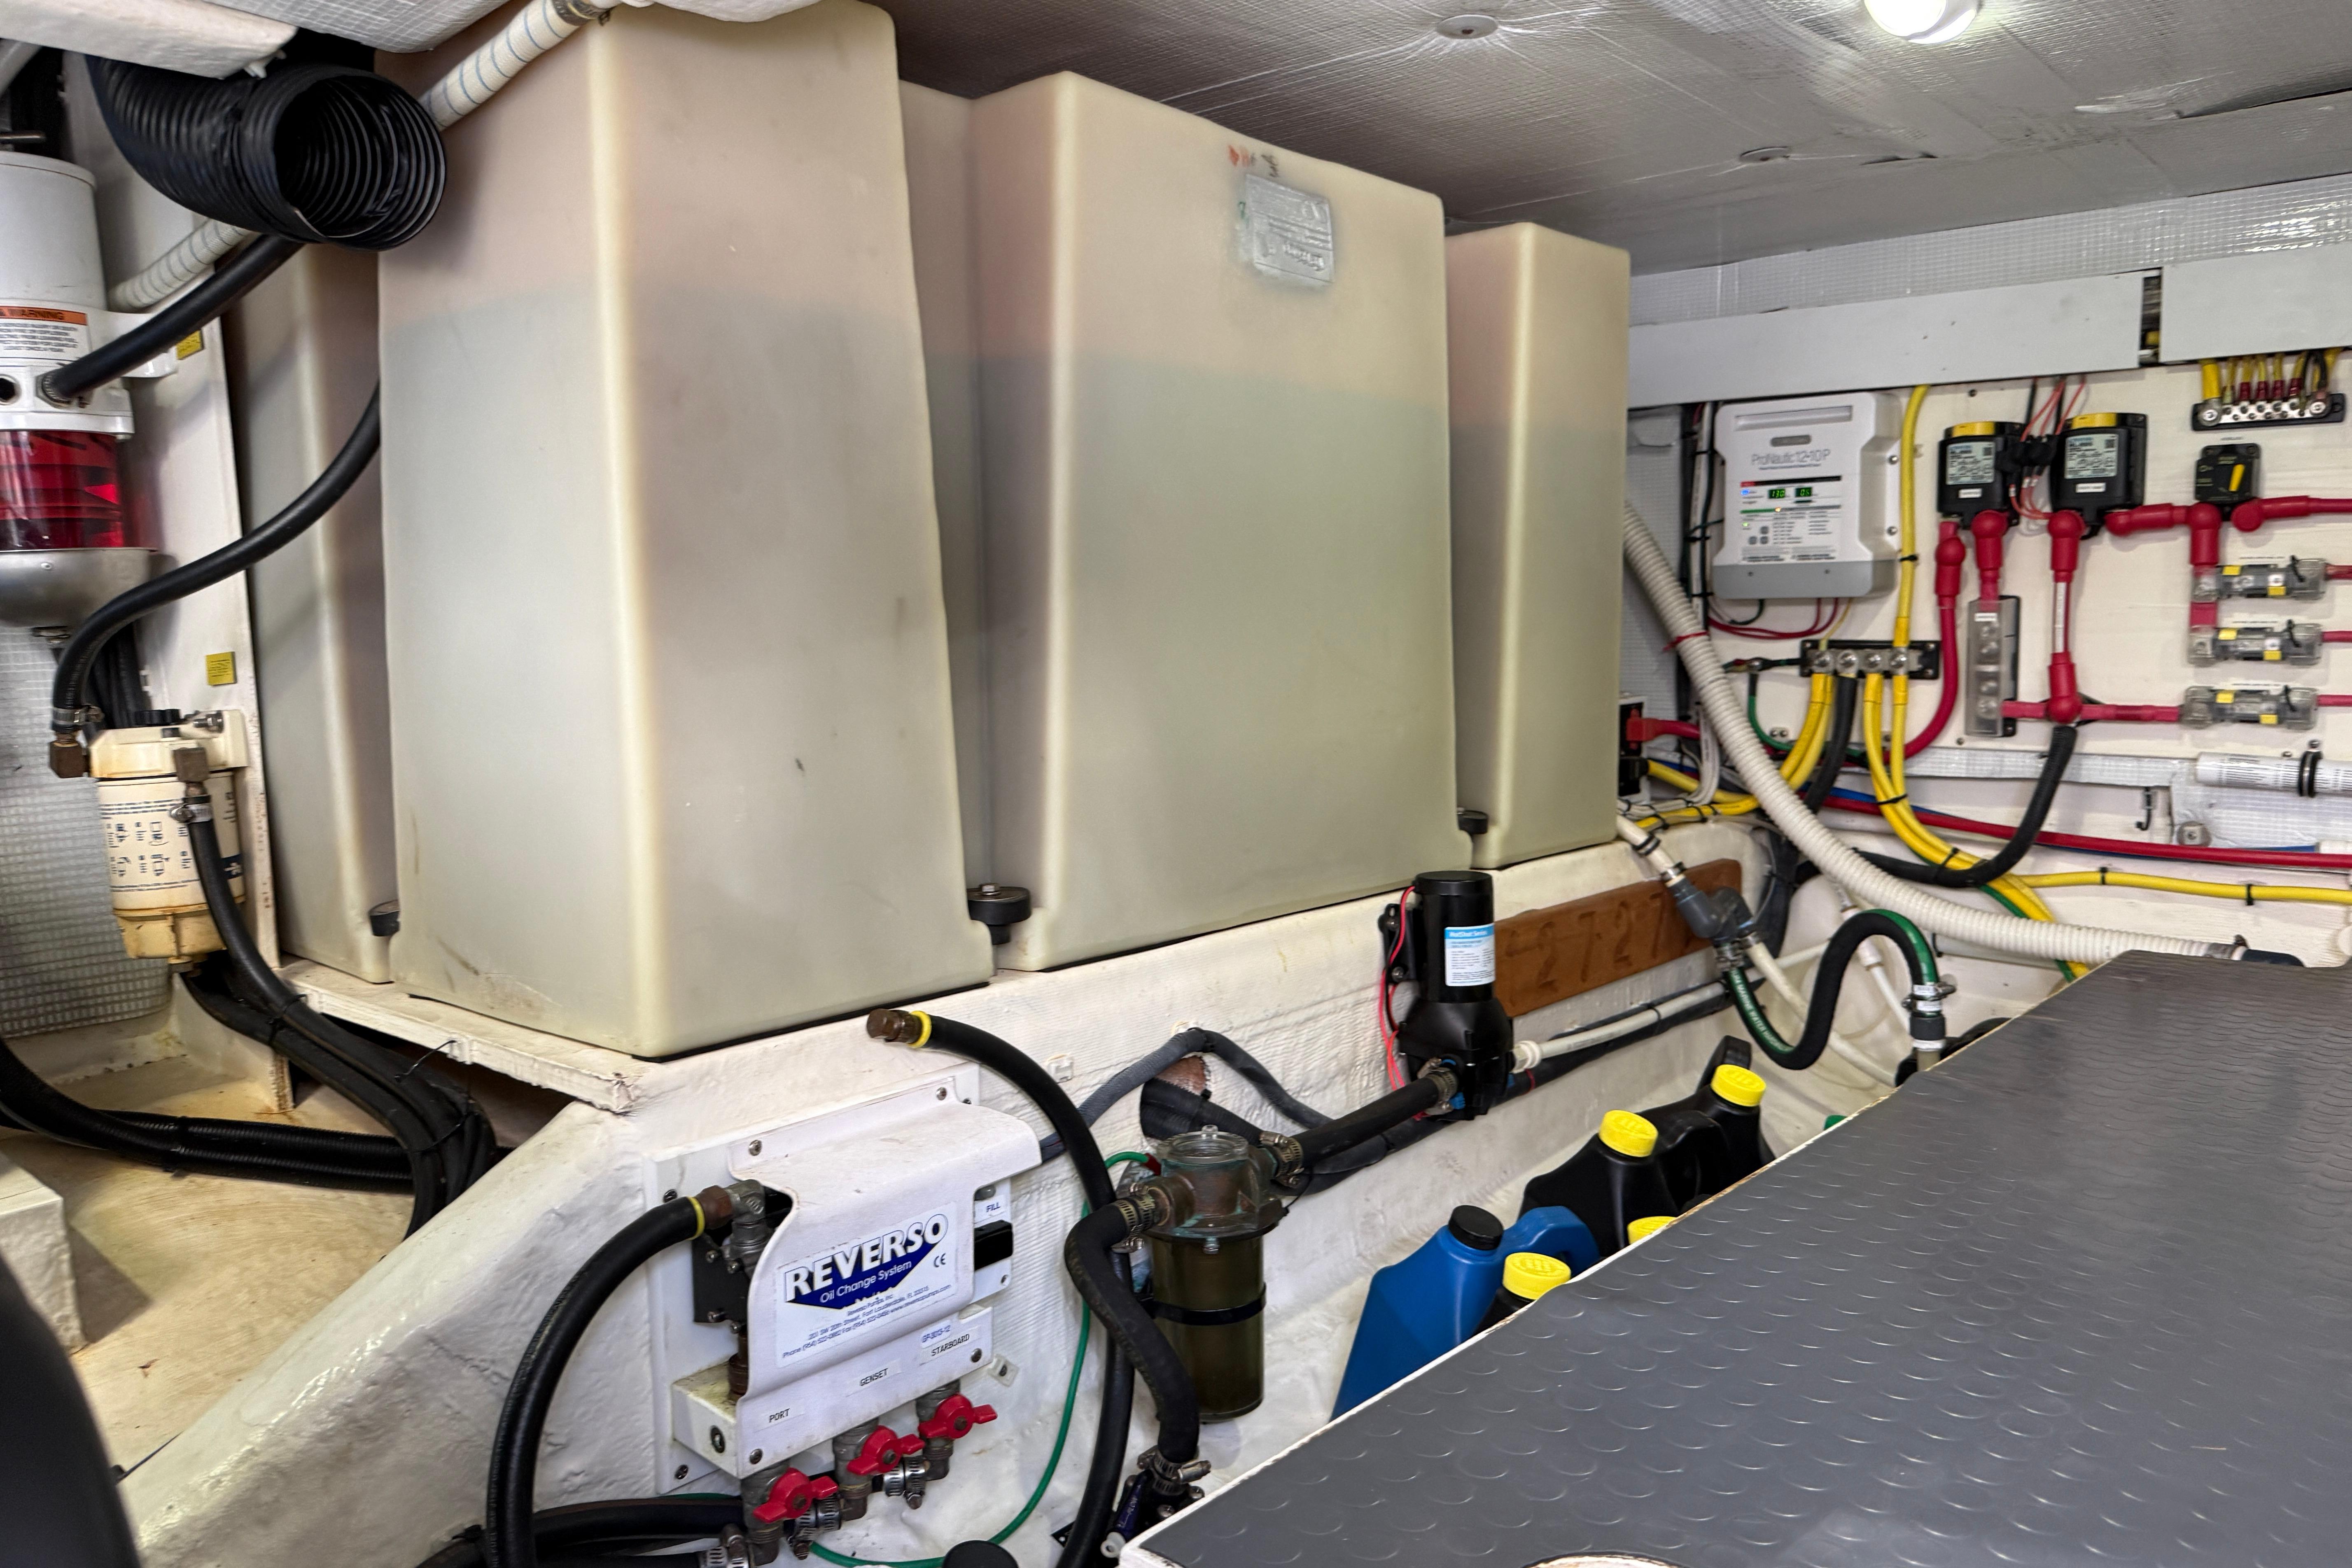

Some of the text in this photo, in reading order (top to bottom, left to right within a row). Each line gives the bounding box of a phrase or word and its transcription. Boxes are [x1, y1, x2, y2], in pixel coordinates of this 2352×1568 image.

[986, 1202, 1001, 1213] FILL
[784, 1213, 949, 1303] REVERSO
[819, 1261, 912, 1303] Oil Change System
[931, 1333, 970, 1356] STARBOARD
[859, 1367, 889, 1386] GENSET
[769, 1407, 791, 1423] PORT
